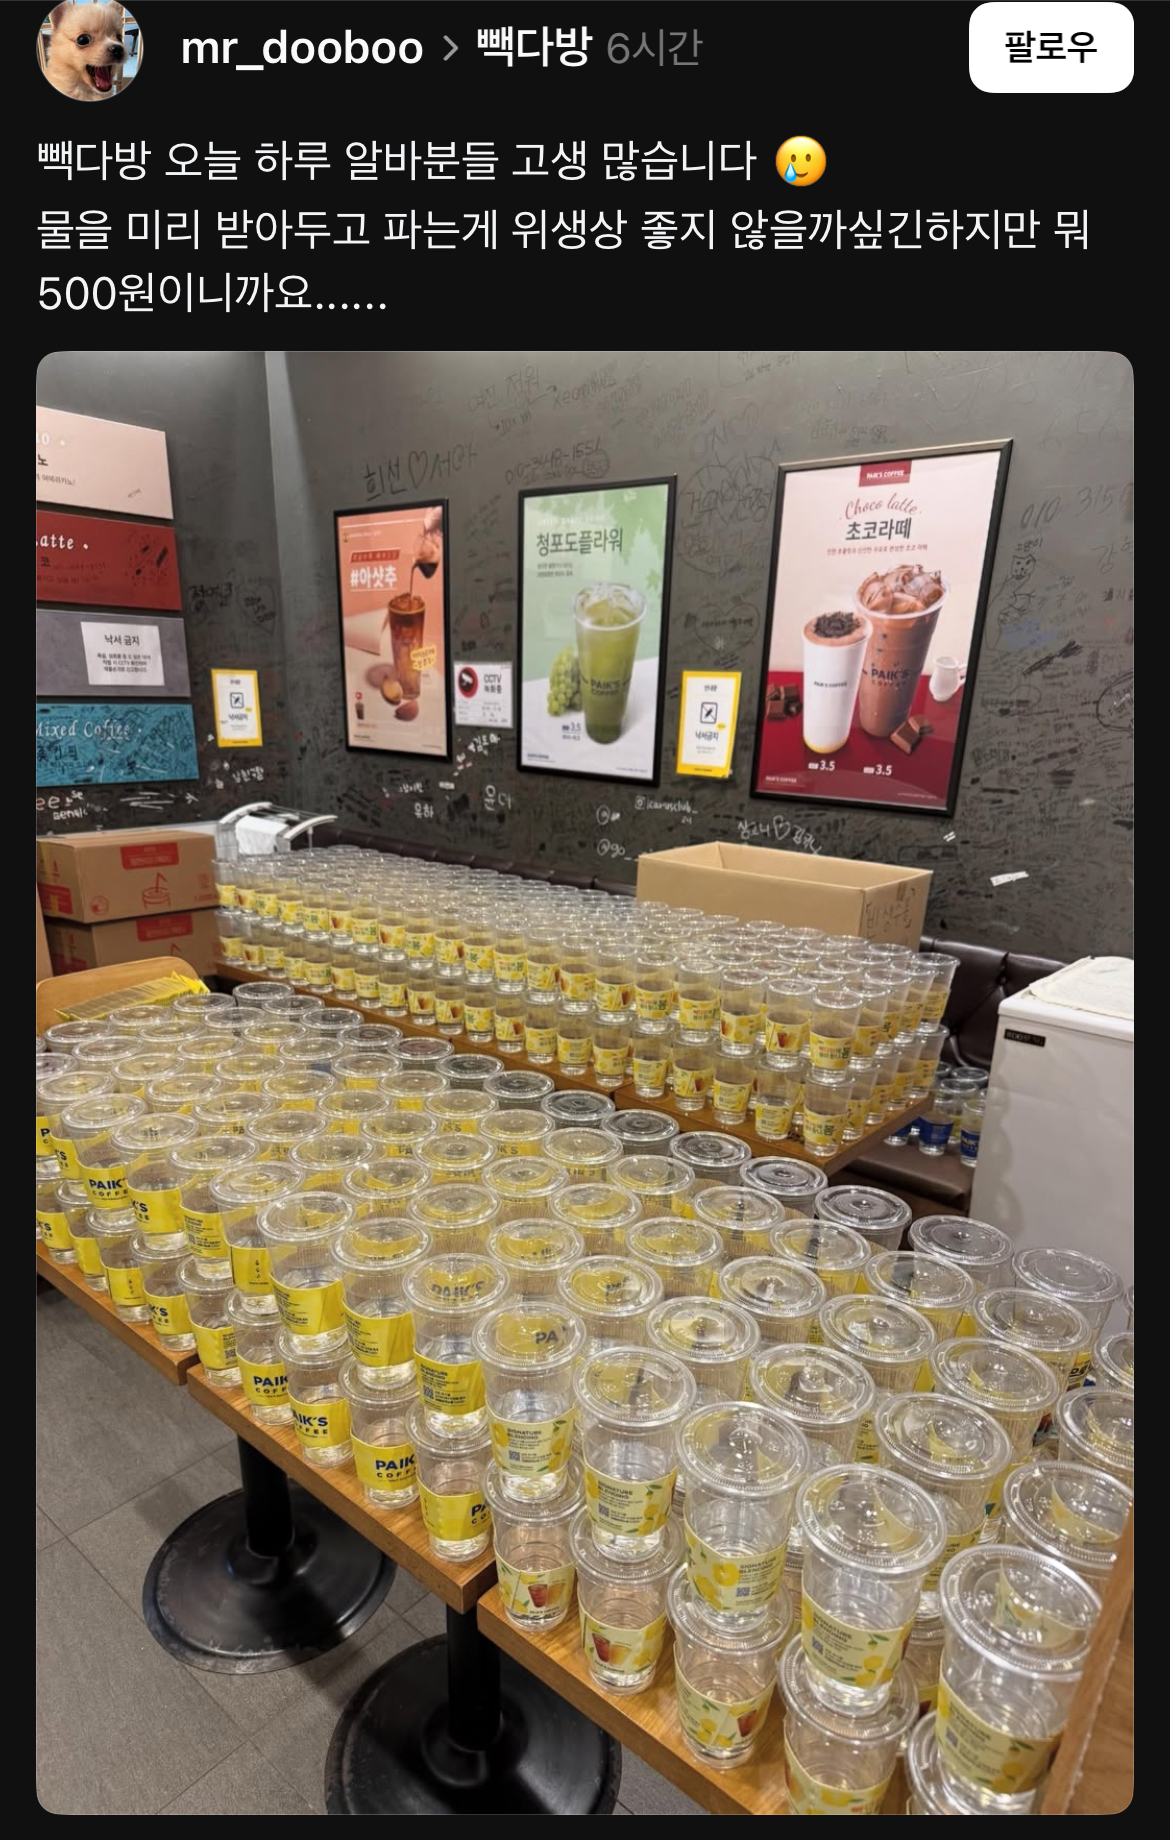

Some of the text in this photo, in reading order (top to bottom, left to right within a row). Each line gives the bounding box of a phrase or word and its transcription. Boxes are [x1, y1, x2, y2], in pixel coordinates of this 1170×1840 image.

[883, 469, 905, 478] COFFEE
[845, 492, 919, 521] Choco latte
[845, 517, 912, 541] 초코라떼
[36, 533, 75, 550] atte
[536, 527, 624, 557] 청포도플라워
[350, 564, 398, 589] #아샷추
[104, 634, 140, 646] 낙서 금지
[484, 674, 502, 684] CCTV
[591, 680, 621, 690] PAIK'S
[828, 680, 848, 688] COFFEE
[83, 721, 132, 741] Coffee
[570, 722, 582, 732] 3.5
[819, 760, 836, 771] 3.5
[875, 764, 893, 776] 3.5
[88, 1177, 127, 1190] PAIK'
[92, 1189, 129, 1197] COFFE
[253, 1375, 289, 1387] PAIK
[255, 1386, 287, 1394] COFF
[292, 1410, 329, 1427] IK'S
[375, 1453, 416, 1471] PAIK
[376, 1467, 416, 1479] COFF
